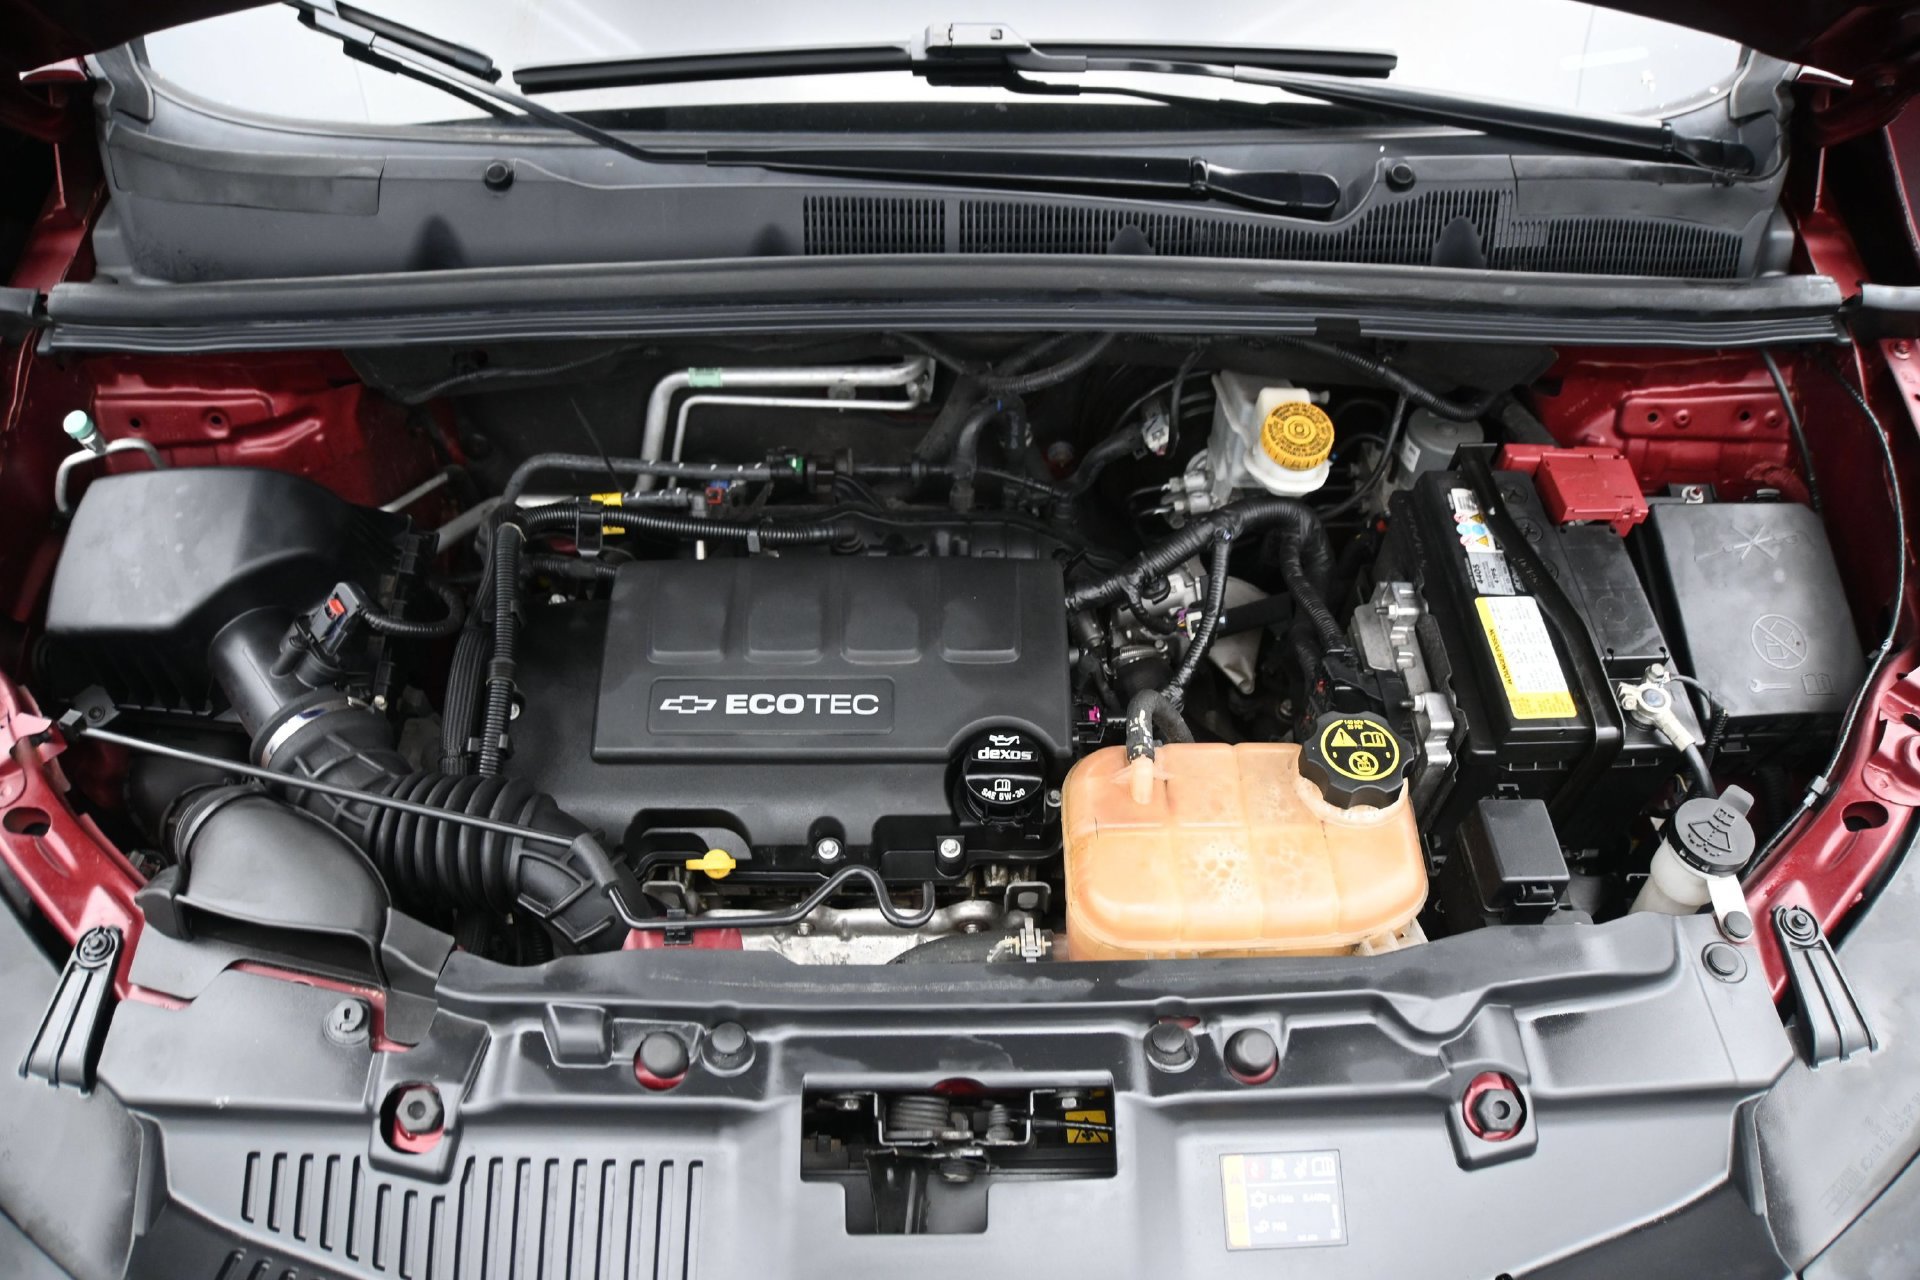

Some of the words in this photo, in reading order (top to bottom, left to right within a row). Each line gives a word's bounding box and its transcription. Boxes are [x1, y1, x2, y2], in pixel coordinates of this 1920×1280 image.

[726, 693, 879, 715] ECOTEC
[977, 746, 1033, 760] dexos
[981, 787, 997, 801] SAE
